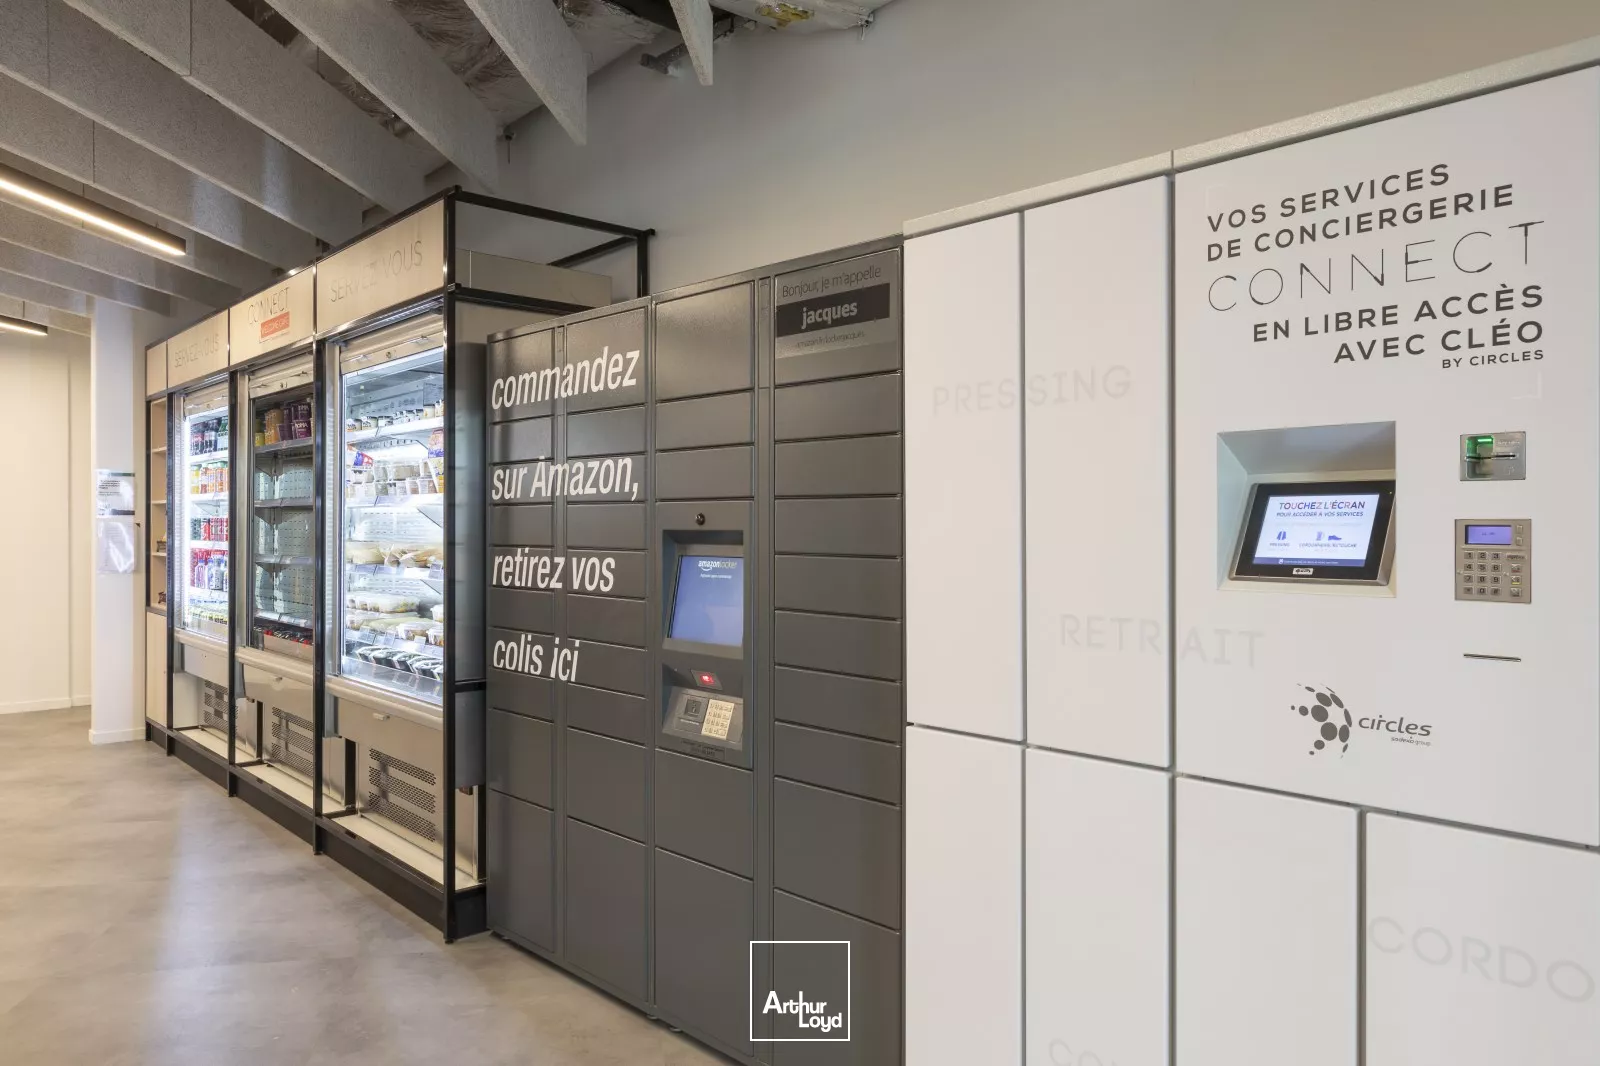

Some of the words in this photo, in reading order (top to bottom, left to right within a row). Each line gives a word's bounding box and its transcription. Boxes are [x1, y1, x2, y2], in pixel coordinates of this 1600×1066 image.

[1207, 203, 1267, 233] VOS
[1279, 163, 1450, 219] SERVICES
[1207, 238, 1242, 262] DE
[1253, 184, 1514, 253] CONCIERGERIE
[782, 280, 819, 298] Bonjour,
[821, 276, 830, 293] je
[832, 265, 882, 287] m'appelle
[1208, 220, 1545, 312] CONNECT
[801, 302, 858, 330] jacques
[1253, 319, 1290, 342] EN
[1304, 304, 1399, 336] LIBRE
[1413, 283, 1543, 322] ACCÈS
[1333, 333, 1426, 364] AVEC
[1440, 318, 1543, 352] CLÉO
[1442, 358, 1462, 369] BY
[1469, 349, 1545, 367] CIRCLES
[491, 346, 640, 410] commandez
[932, 364, 1132, 417] PRESSING
[491, 463, 527, 501] sur
[530, 456, 639, 502] Amazon,
[1279, 502, 1322, 510] TOUCHEZ
[1324, 499, 1366, 510] L'ÉCRAN
[492, 547, 566, 589] retirez
[572, 556, 616, 592] vos
[493, 634, 544, 676] colis
[550, 637, 580, 682] ici
[1059, 613, 1266, 669] RETRAIT
[1358, 714, 1433, 737] circles
[1368, 915, 1596, 1004] CORDO
